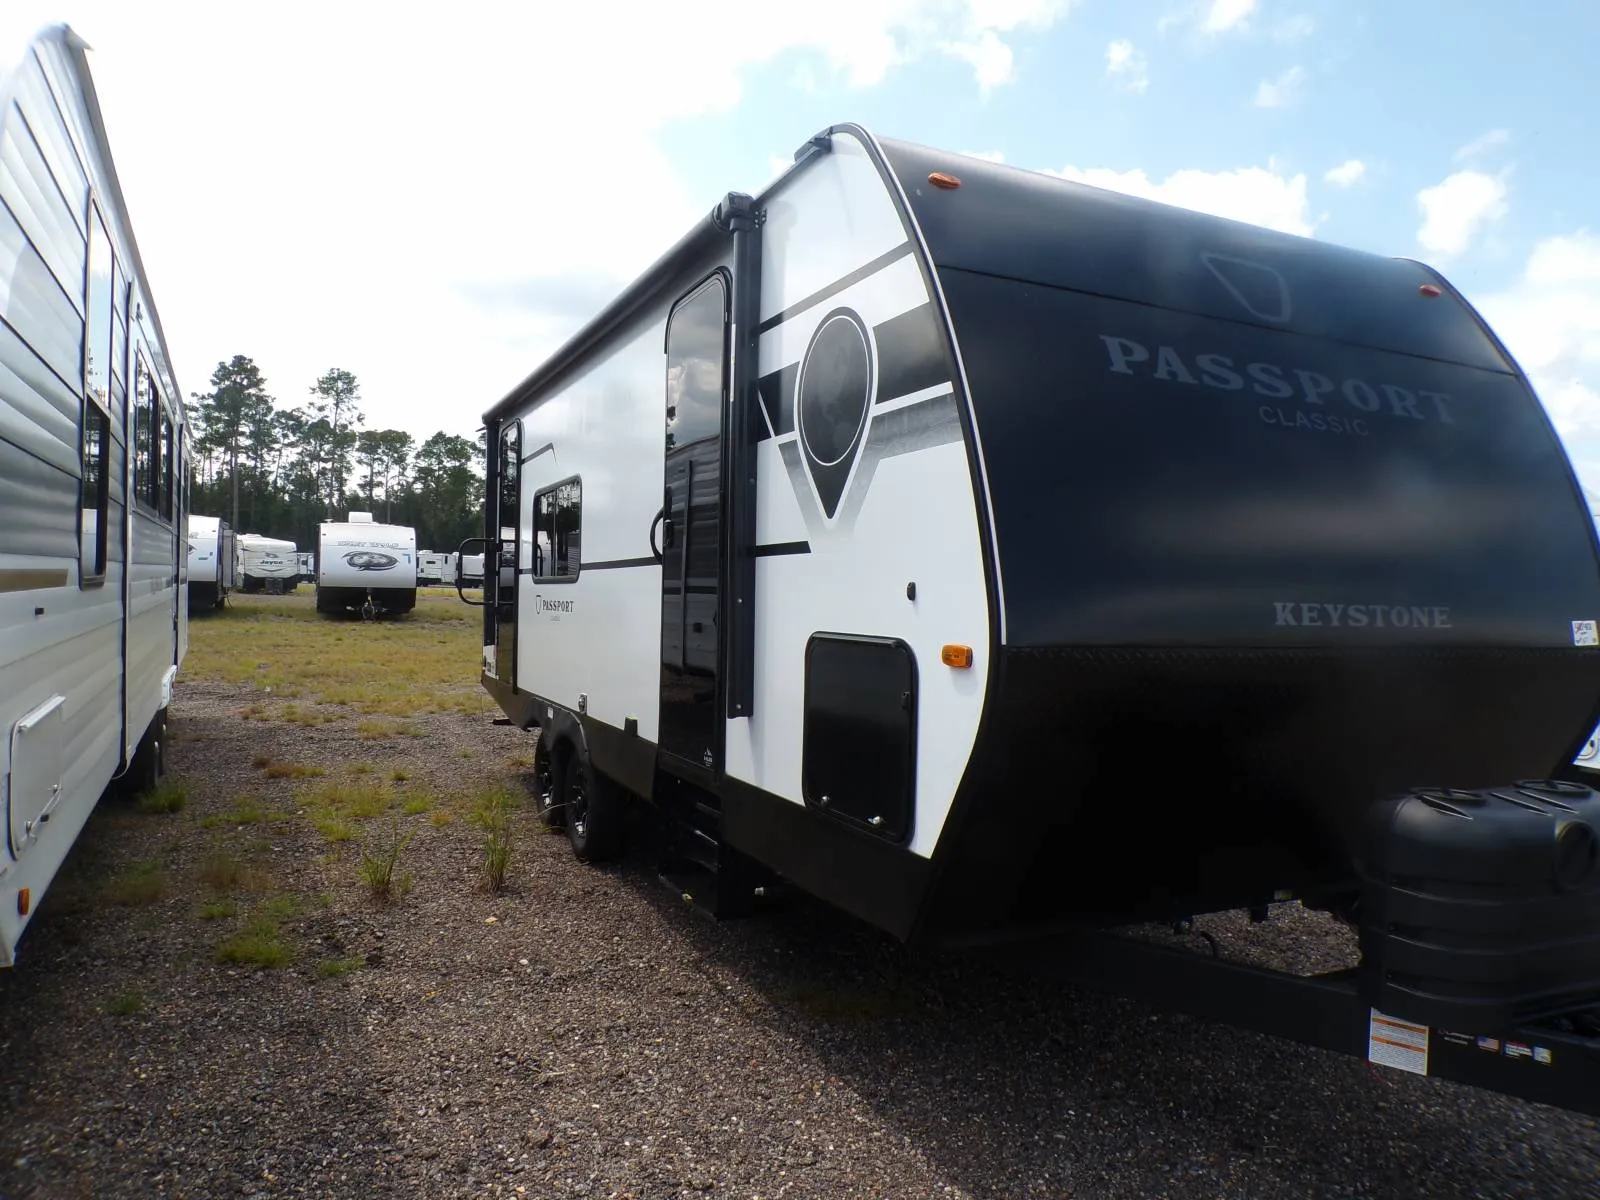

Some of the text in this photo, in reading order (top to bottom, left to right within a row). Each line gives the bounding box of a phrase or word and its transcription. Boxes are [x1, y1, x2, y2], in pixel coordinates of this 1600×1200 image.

[1098, 334, 1455, 424] PASSPORT
[1258, 405, 1370, 436] CLASSIC
[542, 600, 574, 613] PASSPORT
[1273, 601, 1453, 629] KEYSTONE
